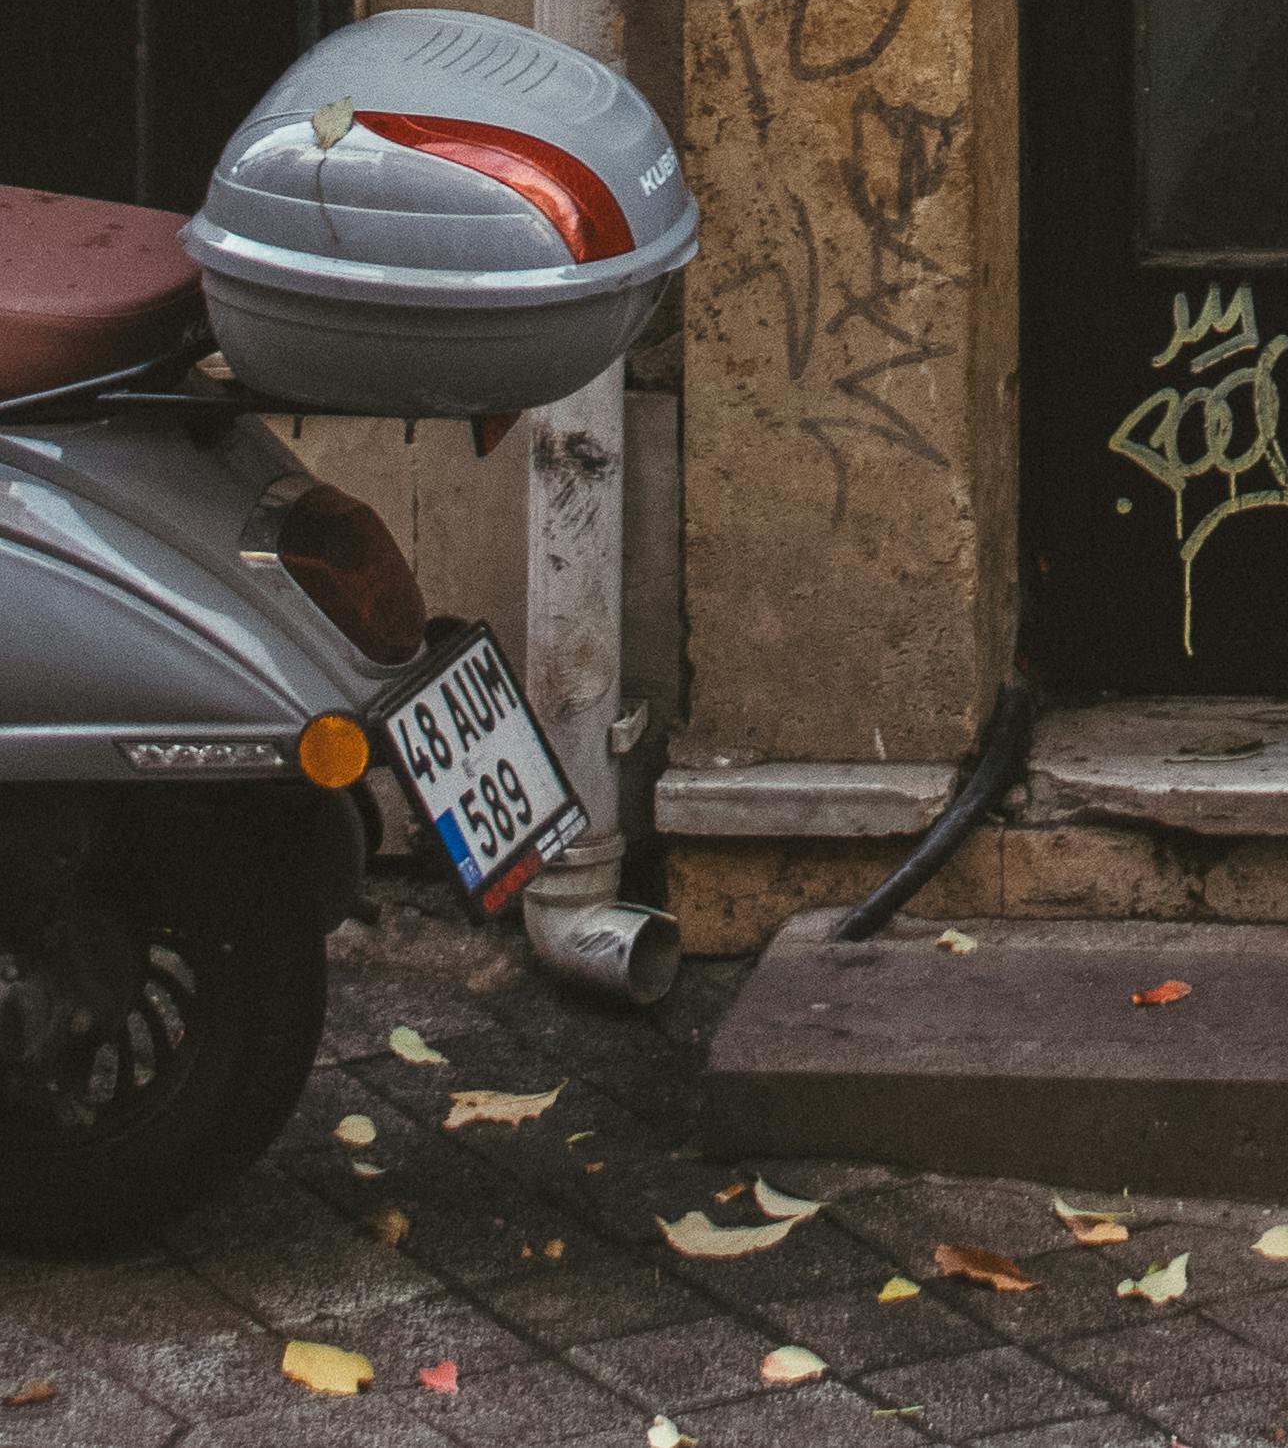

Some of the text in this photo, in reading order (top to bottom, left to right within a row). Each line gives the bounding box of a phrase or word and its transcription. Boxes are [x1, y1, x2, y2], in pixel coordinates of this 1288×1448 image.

[397, 644, 519, 784] 48 AUM
[458, 757, 534, 859] 589
